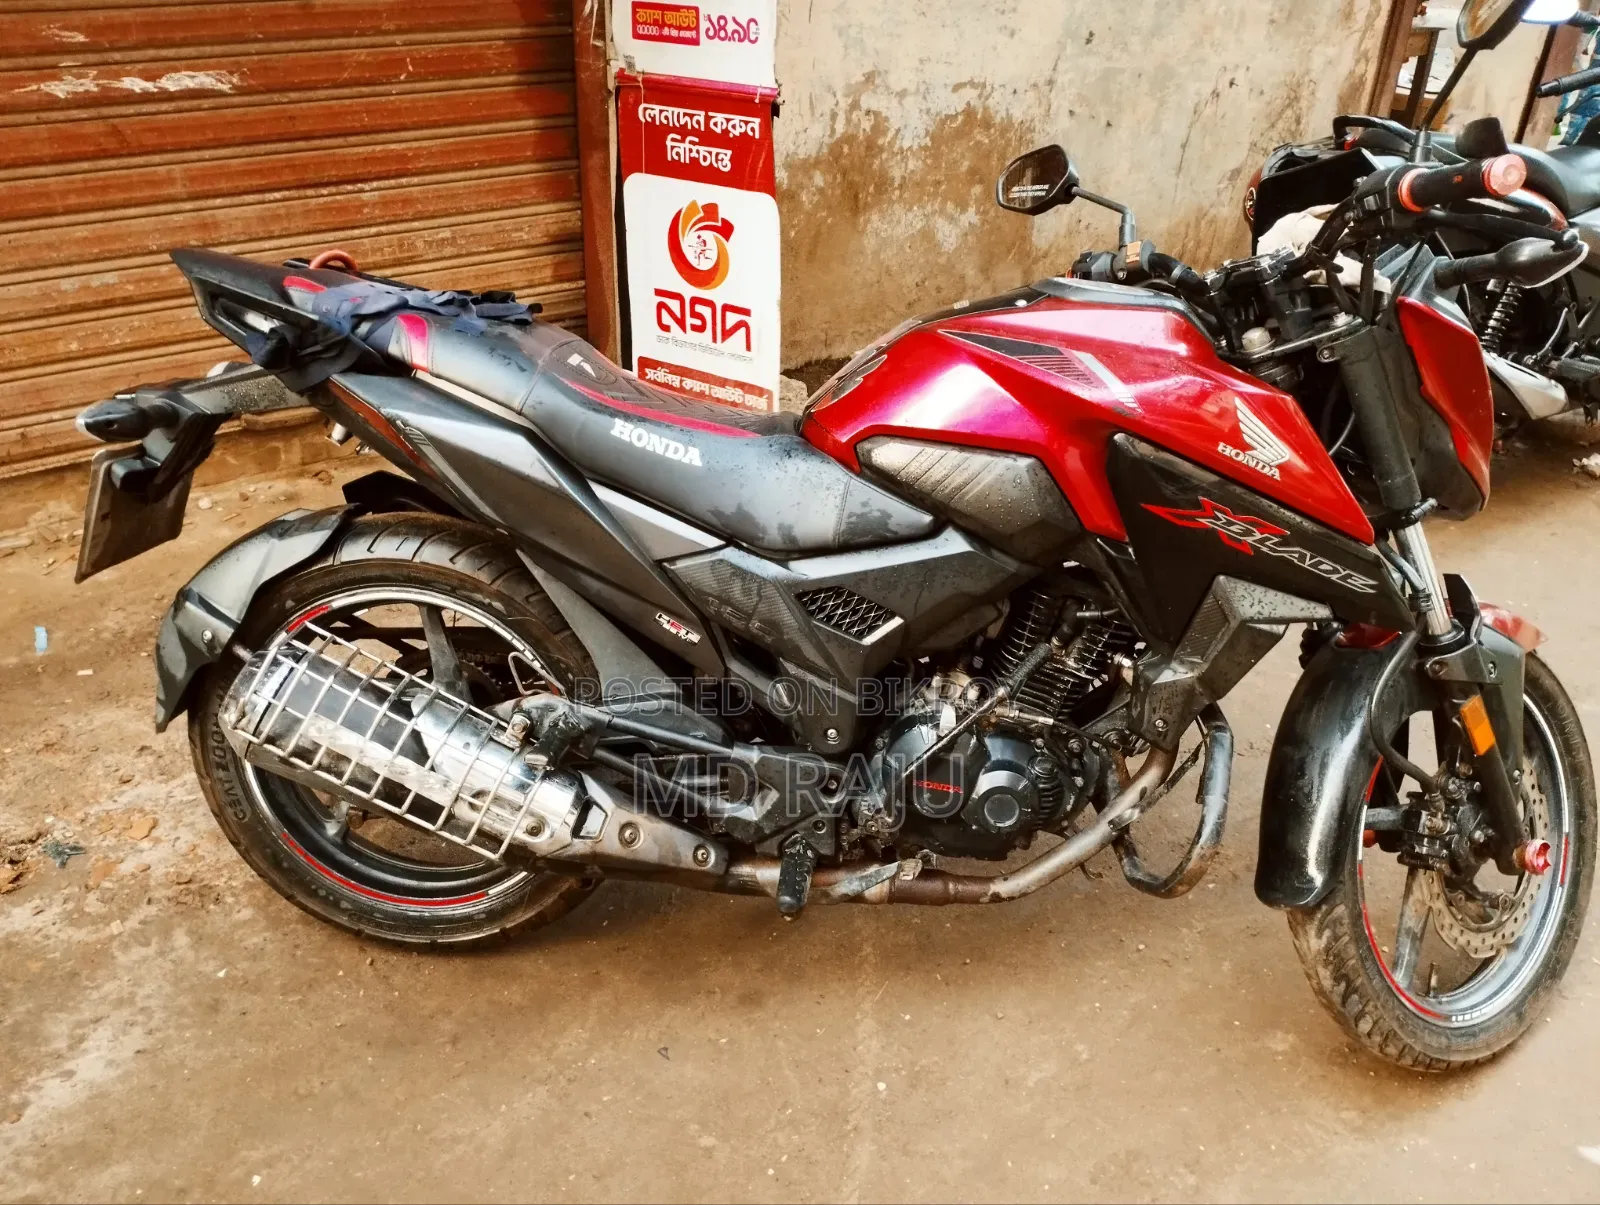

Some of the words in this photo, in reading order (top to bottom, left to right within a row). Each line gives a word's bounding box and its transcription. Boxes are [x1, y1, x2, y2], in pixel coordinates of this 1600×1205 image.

[636, 8, 662, 25] ক্যাশ
[664, 9, 697, 28] আউট
[638, 103, 705, 131] লেনদেন
[708, 111, 761, 139] করুন
[666, 133, 732, 172] নিশ্চিন্তে
[654, 288, 752, 352] নগদ
[682, 377, 710, 395] ক্যাশ
[710, 385, 744, 403] আউট
[610, 418, 702, 466] HONDA
[1217, 441, 1281, 481] HONDA
[220, 777, 247, 822] CEAT
[913, 779, 964, 795] HONDA
